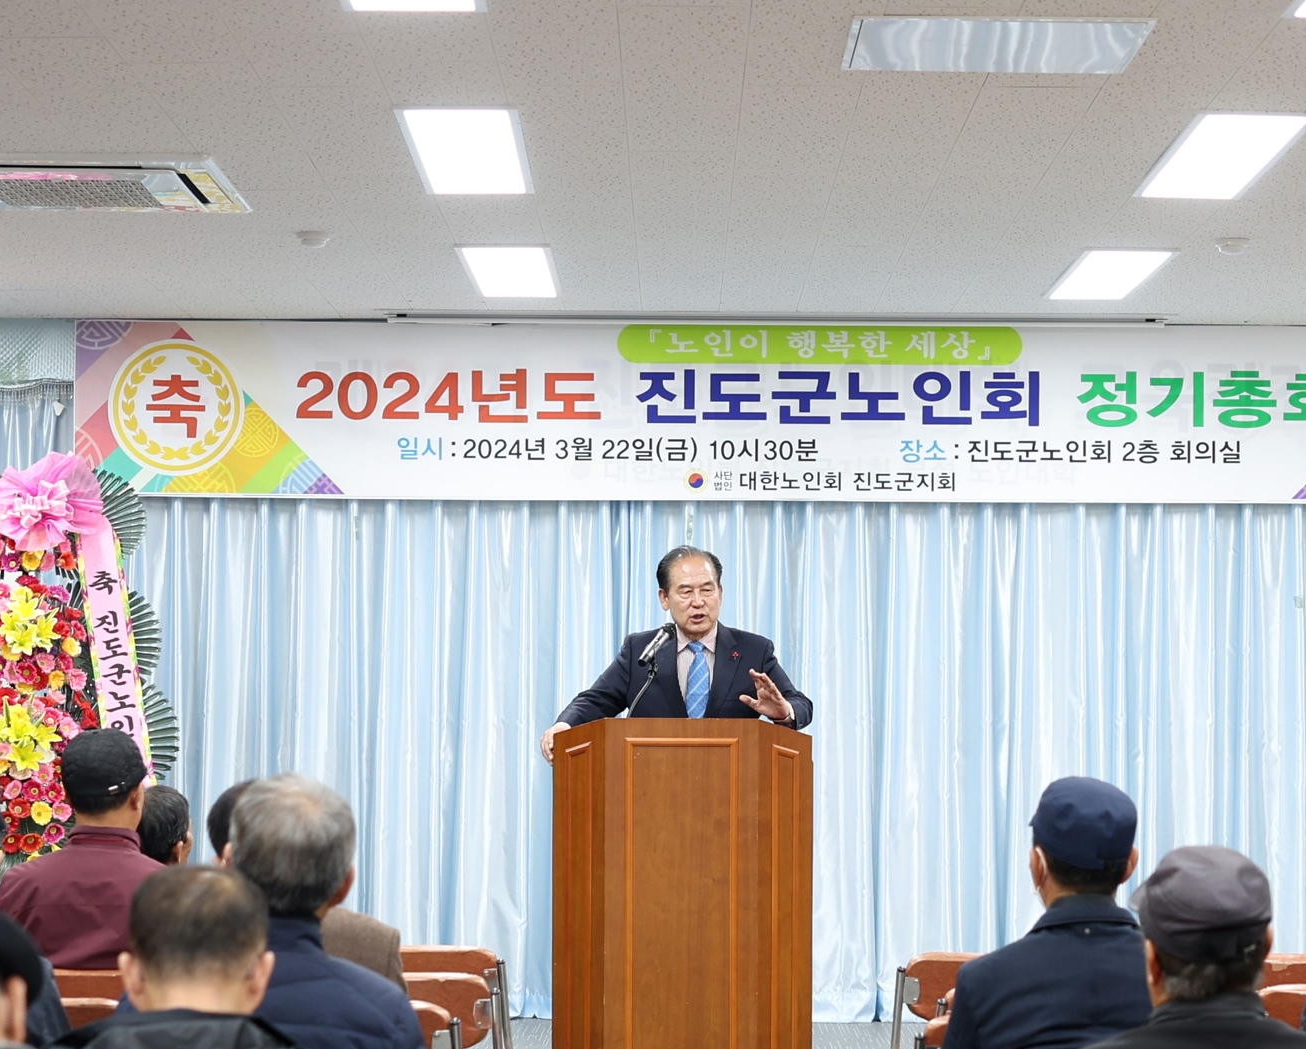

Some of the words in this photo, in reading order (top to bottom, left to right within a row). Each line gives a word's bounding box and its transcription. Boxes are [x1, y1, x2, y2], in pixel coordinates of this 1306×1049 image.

[787, 331, 893, 359] 행복한
[147, 374, 205, 438] 축
[297, 369, 601, 422] 2024년도
[637, 369, 1040, 426] 진도군노인회
[397, 436, 443, 461] 일시
[463, 437, 546, 462] 2024년
[555, 437, 593, 462] 3월
[601, 436, 698, 463] 22일(금)
[709, 438, 819, 463] 10시30분
[899, 439, 947, 464] 장소
[967, 439, 1112, 464] 진도군노인회
[1122, 439, 1160, 465] 2층
[1169, 440, 1241, 464] 회의실
[713, 470, 733, 481] 사단
[739, 471, 842, 492] 대한노인회
[853, 472, 956, 492] 진도군지회
[88, 570, 118, 595] 축
